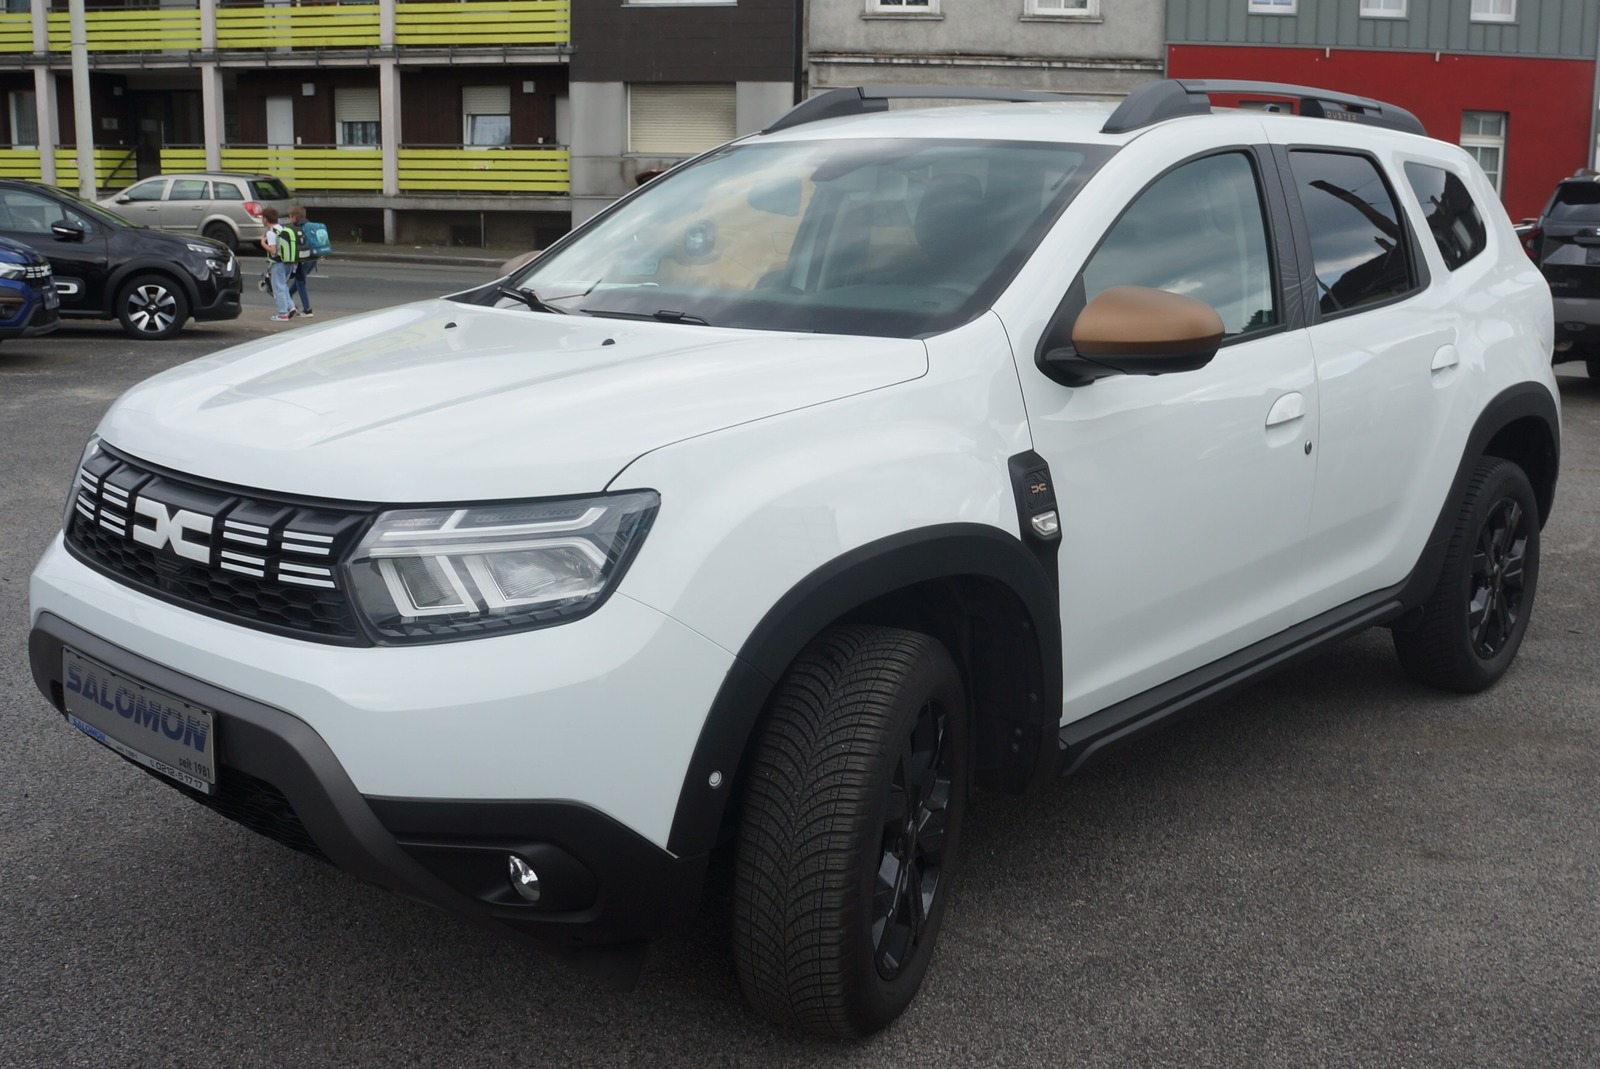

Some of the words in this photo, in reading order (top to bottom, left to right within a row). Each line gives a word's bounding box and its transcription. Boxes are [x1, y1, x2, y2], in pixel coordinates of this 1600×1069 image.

[1326, 111, 1357, 120] DUSTER
[66, 662, 210, 753] SALOMON
[178, 757, 192, 771] seit
[194, 761, 211, 780] 1981
